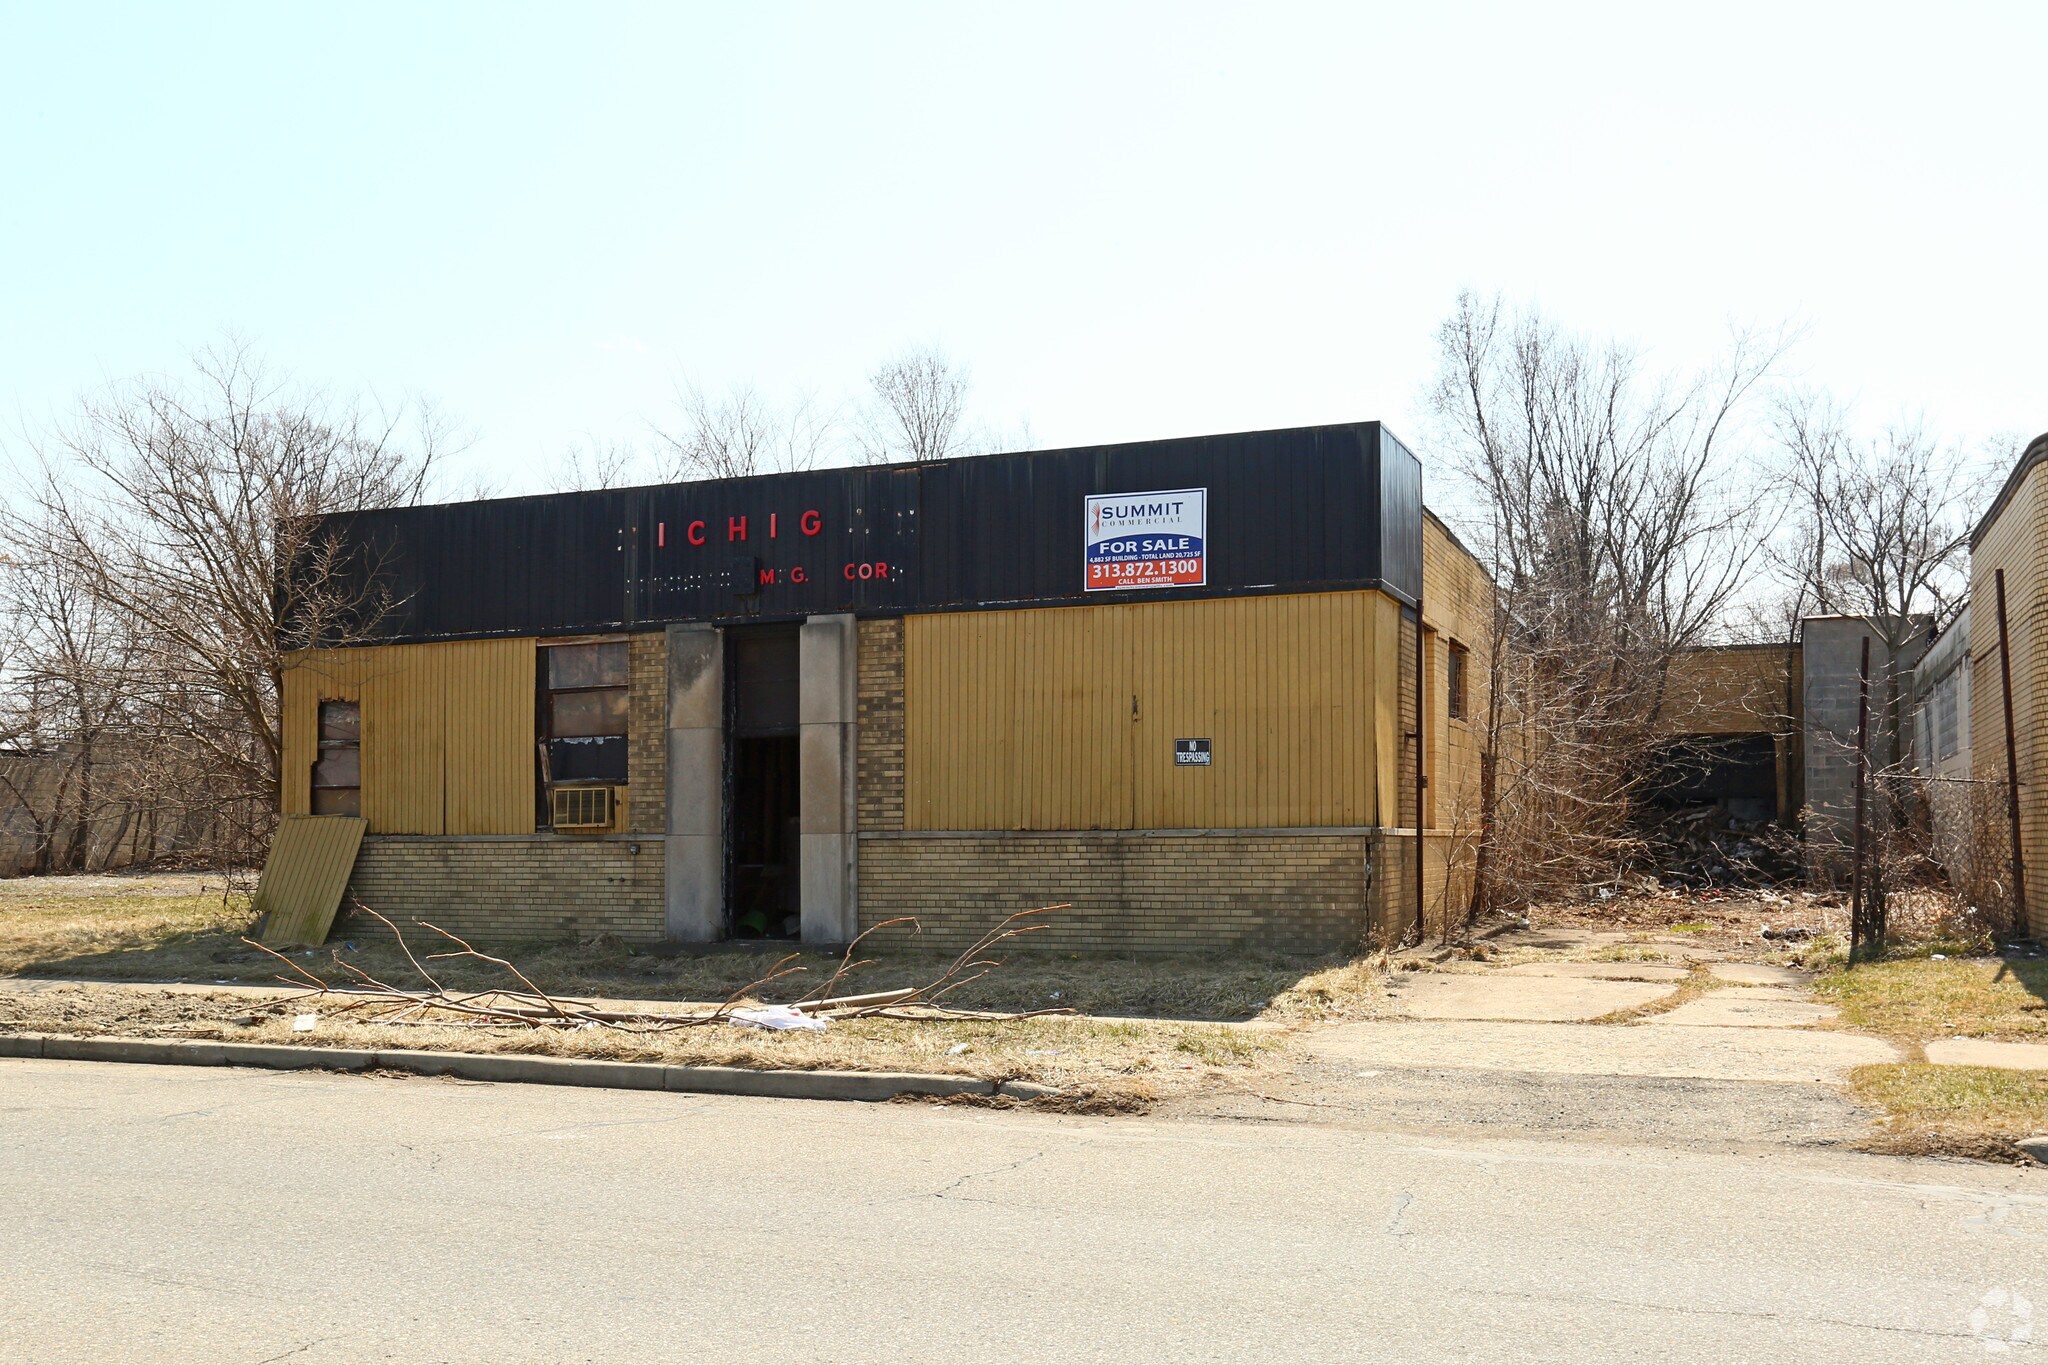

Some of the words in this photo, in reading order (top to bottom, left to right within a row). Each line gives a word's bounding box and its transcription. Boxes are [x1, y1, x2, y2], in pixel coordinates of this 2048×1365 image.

[1102, 502, 1184, 519] SUMMIT
[1102, 516, 1182, 527] COMMERCIAL
[1100, 541, 1137, 554] FOR
[1142, 538, 1189, 551] SALE
[1112, 554, 1138, 562] BUILDING
[1093, 560, 1197, 578] 313.872.1300
[1118, 577, 1134, 585] CALL
[1189, 740, 1197, 751] NO
[1176, 751, 1210, 763] TRESPASSING
